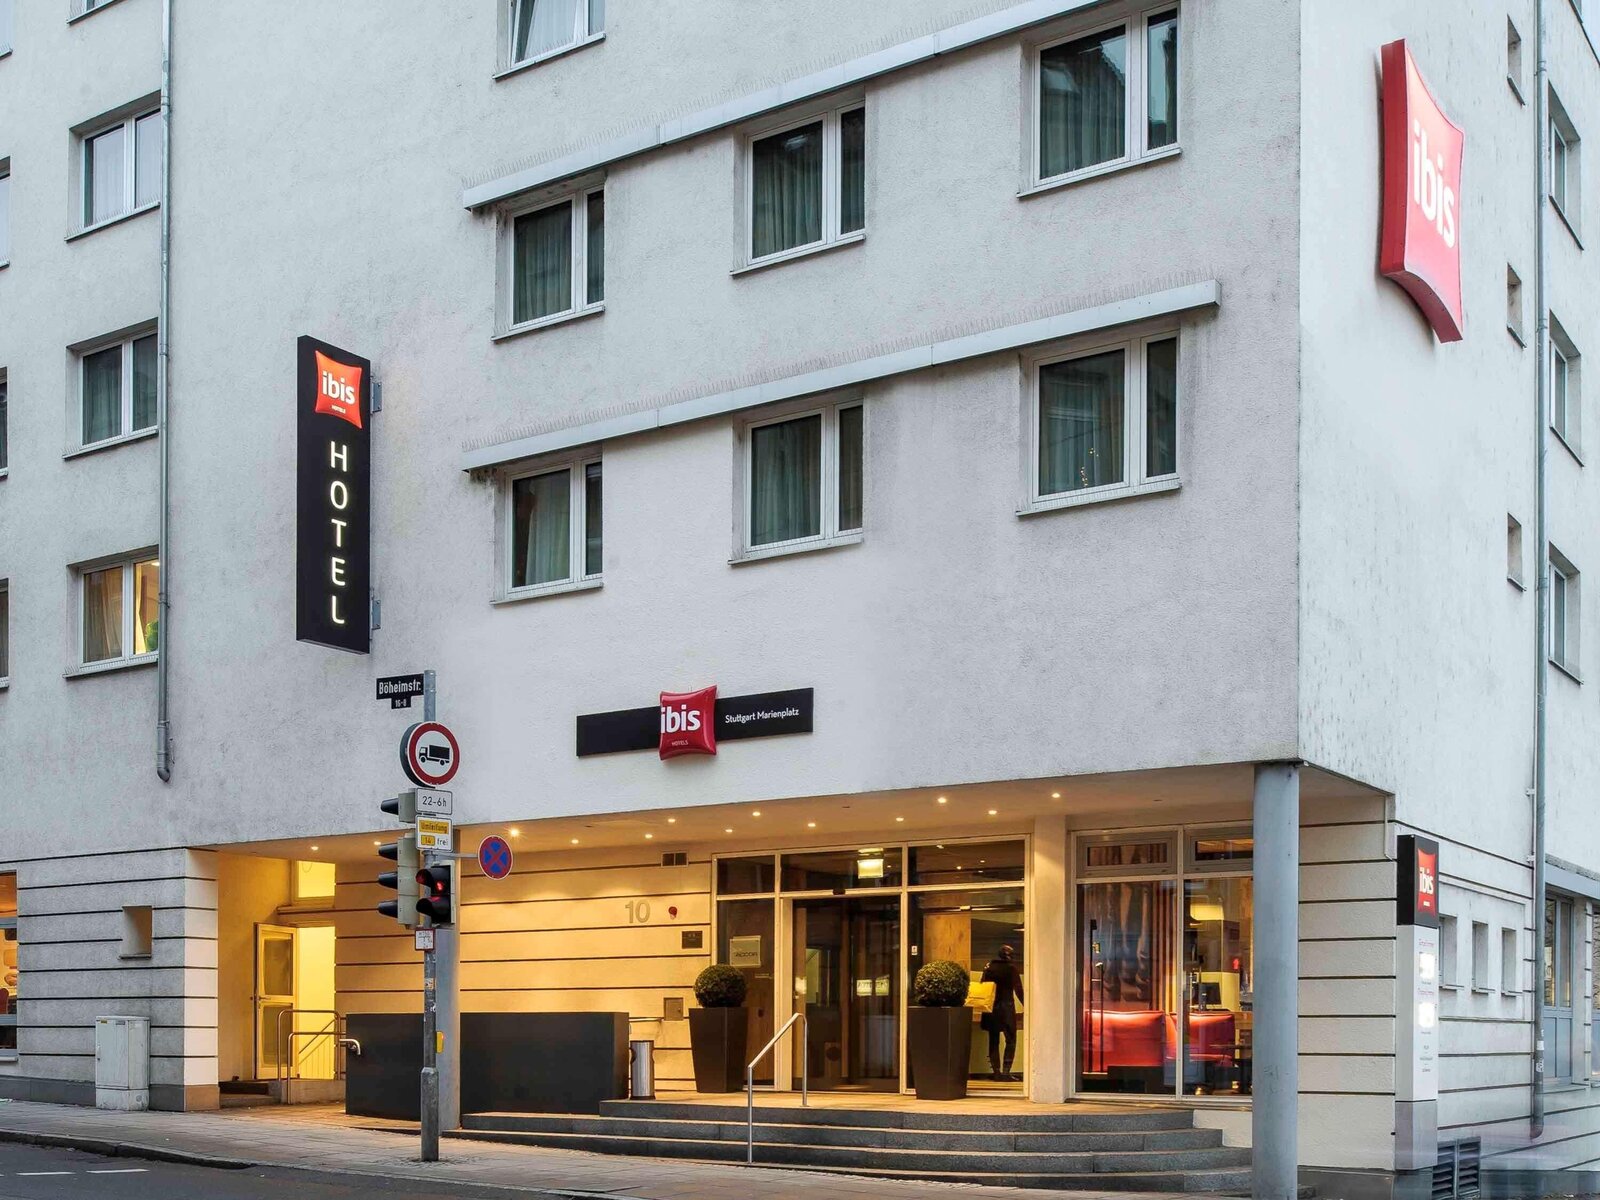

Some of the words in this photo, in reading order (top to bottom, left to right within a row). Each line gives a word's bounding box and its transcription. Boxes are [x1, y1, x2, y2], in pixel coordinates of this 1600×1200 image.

[1414, 119, 1455, 248] ibis
[322, 370, 355, 404] ibis
[330, 441, 348, 624] HOTEL
[379, 679, 421, 694] Böheimstr.
[661, 704, 700, 733] ibis
[725, 712, 756, 723] Stuttgart
[757, 707, 799, 719] Marienplatz
[437, 837, 448, 845] frei
[1419, 866, 1434, 895] ibis
[625, 900, 650, 923] 10
